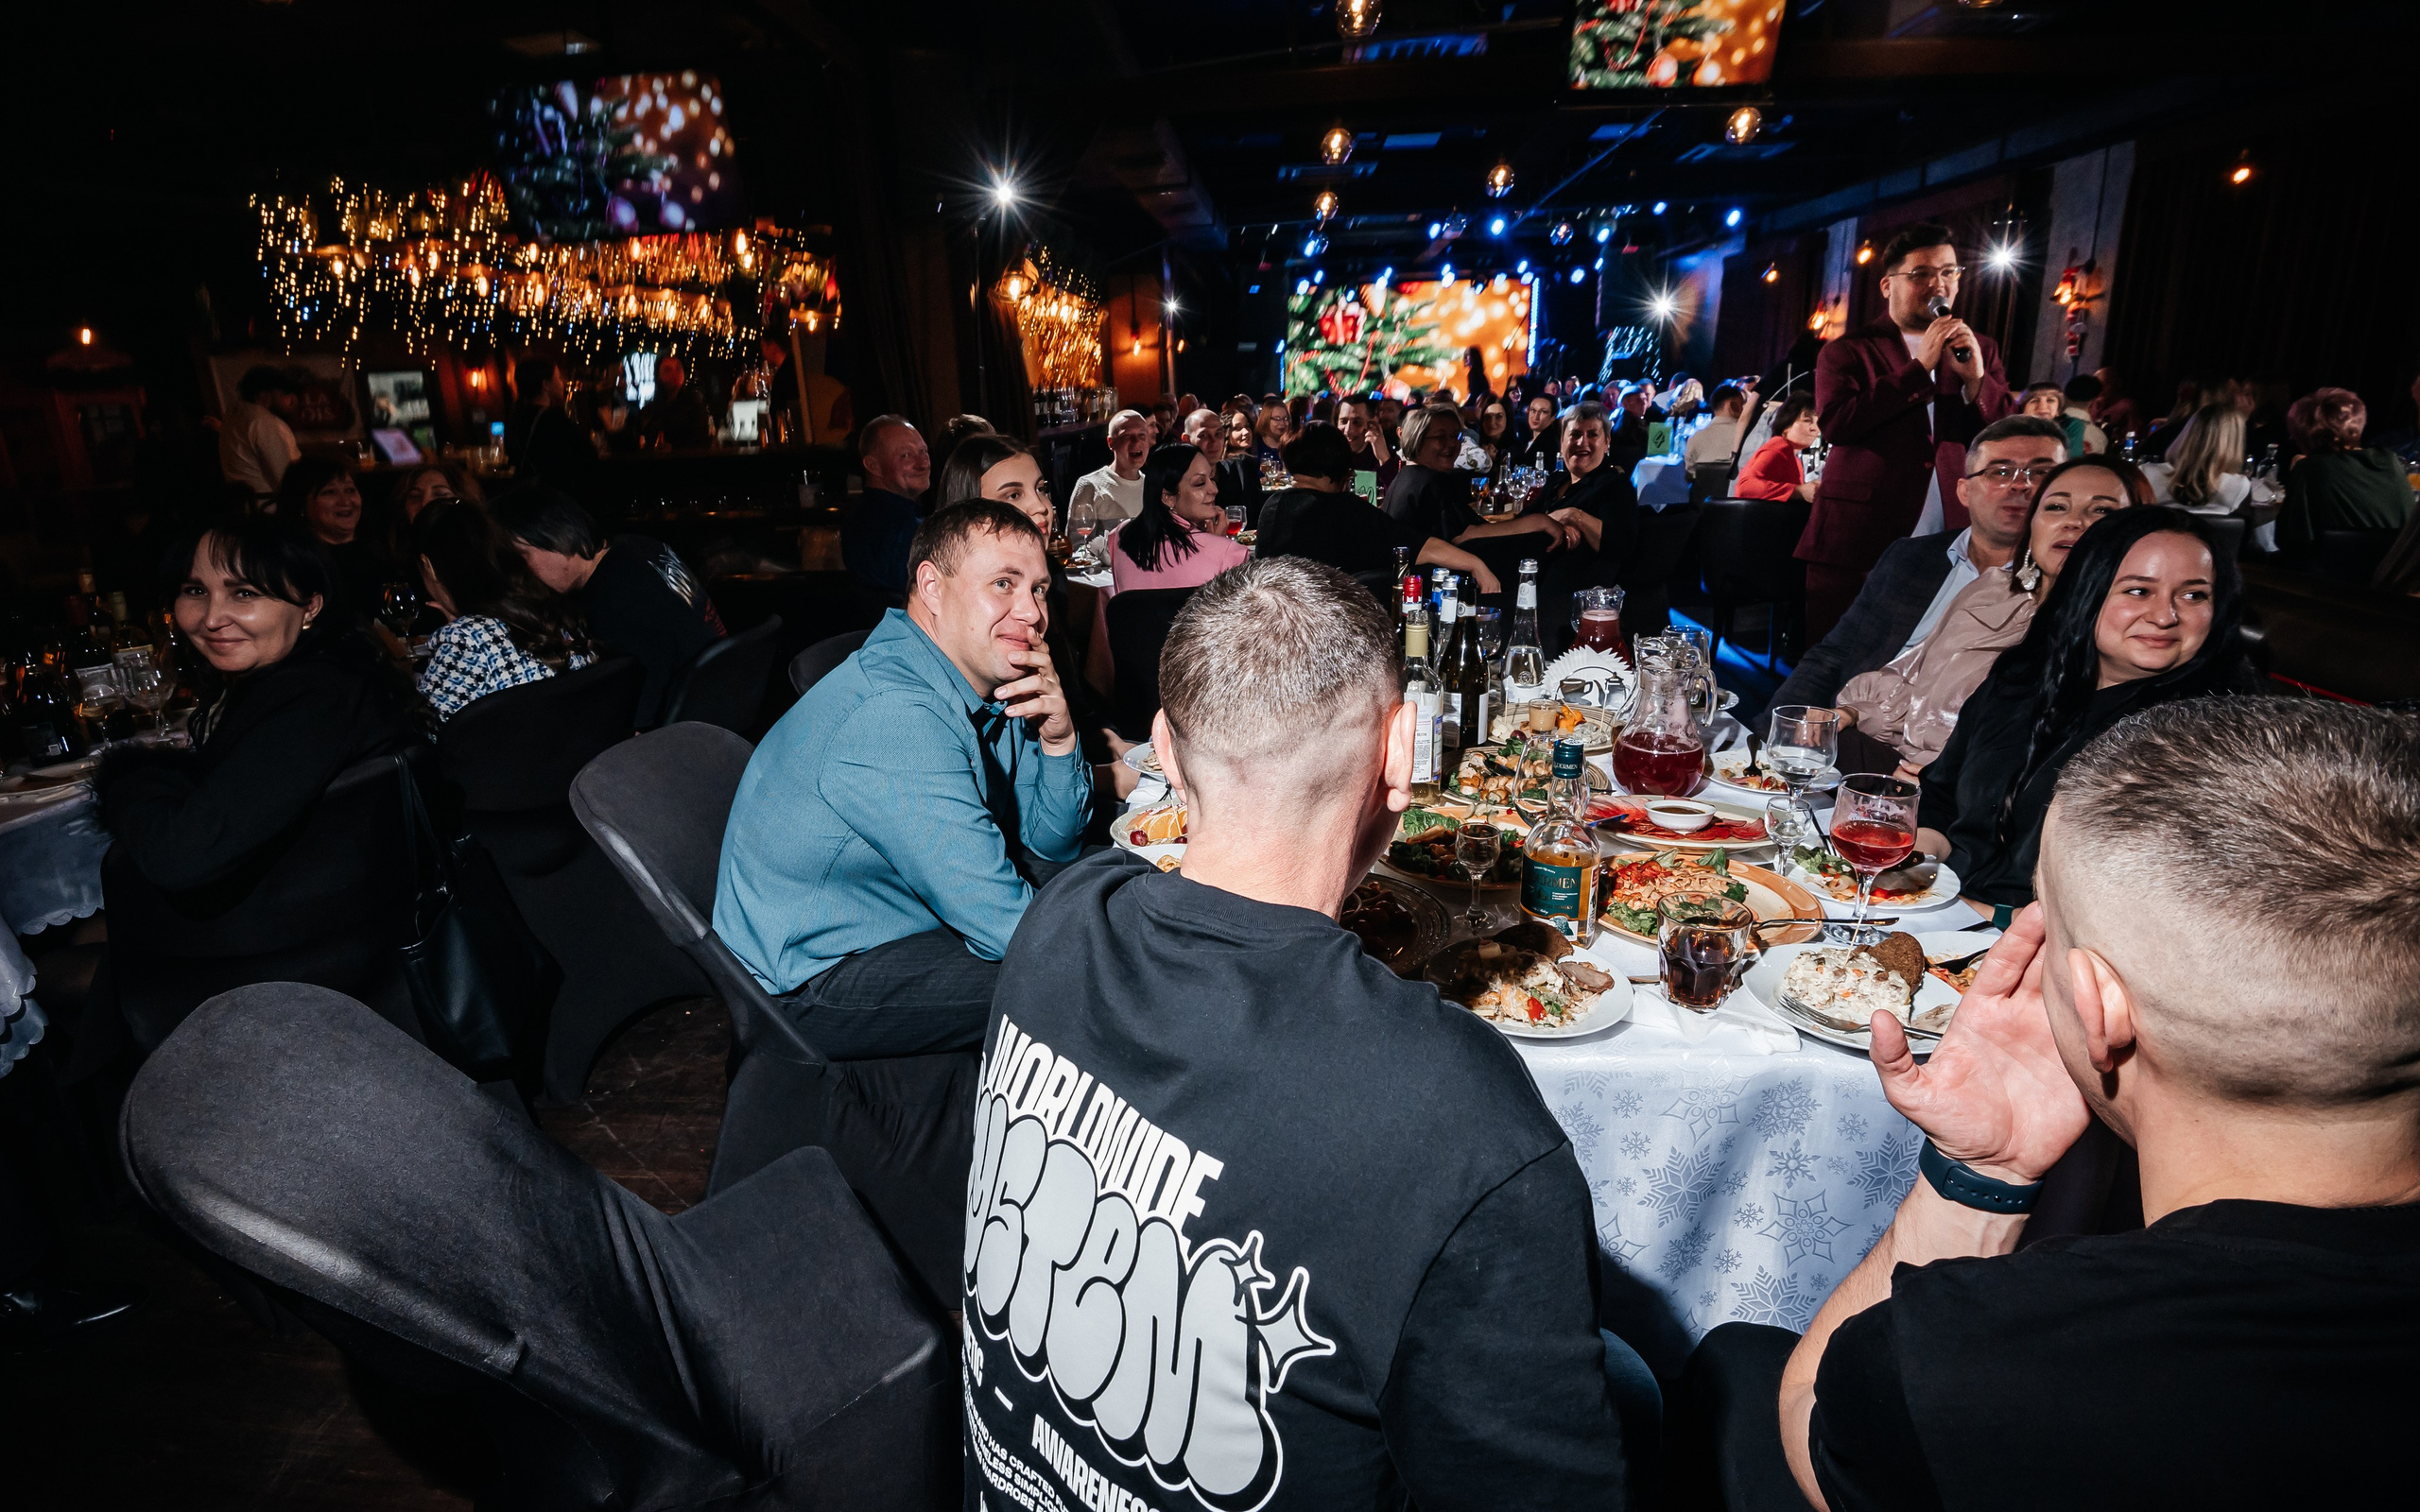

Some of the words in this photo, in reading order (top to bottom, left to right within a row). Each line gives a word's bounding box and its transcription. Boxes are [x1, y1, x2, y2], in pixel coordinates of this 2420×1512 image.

[982, 1458, 1035, 1512] WARDROBE
[988, 1435, 1008, 1461] HAS
[1009, 1455, 1055, 1500] CRAFTED
[1031, 1414, 1161, 1512] AWARENE
